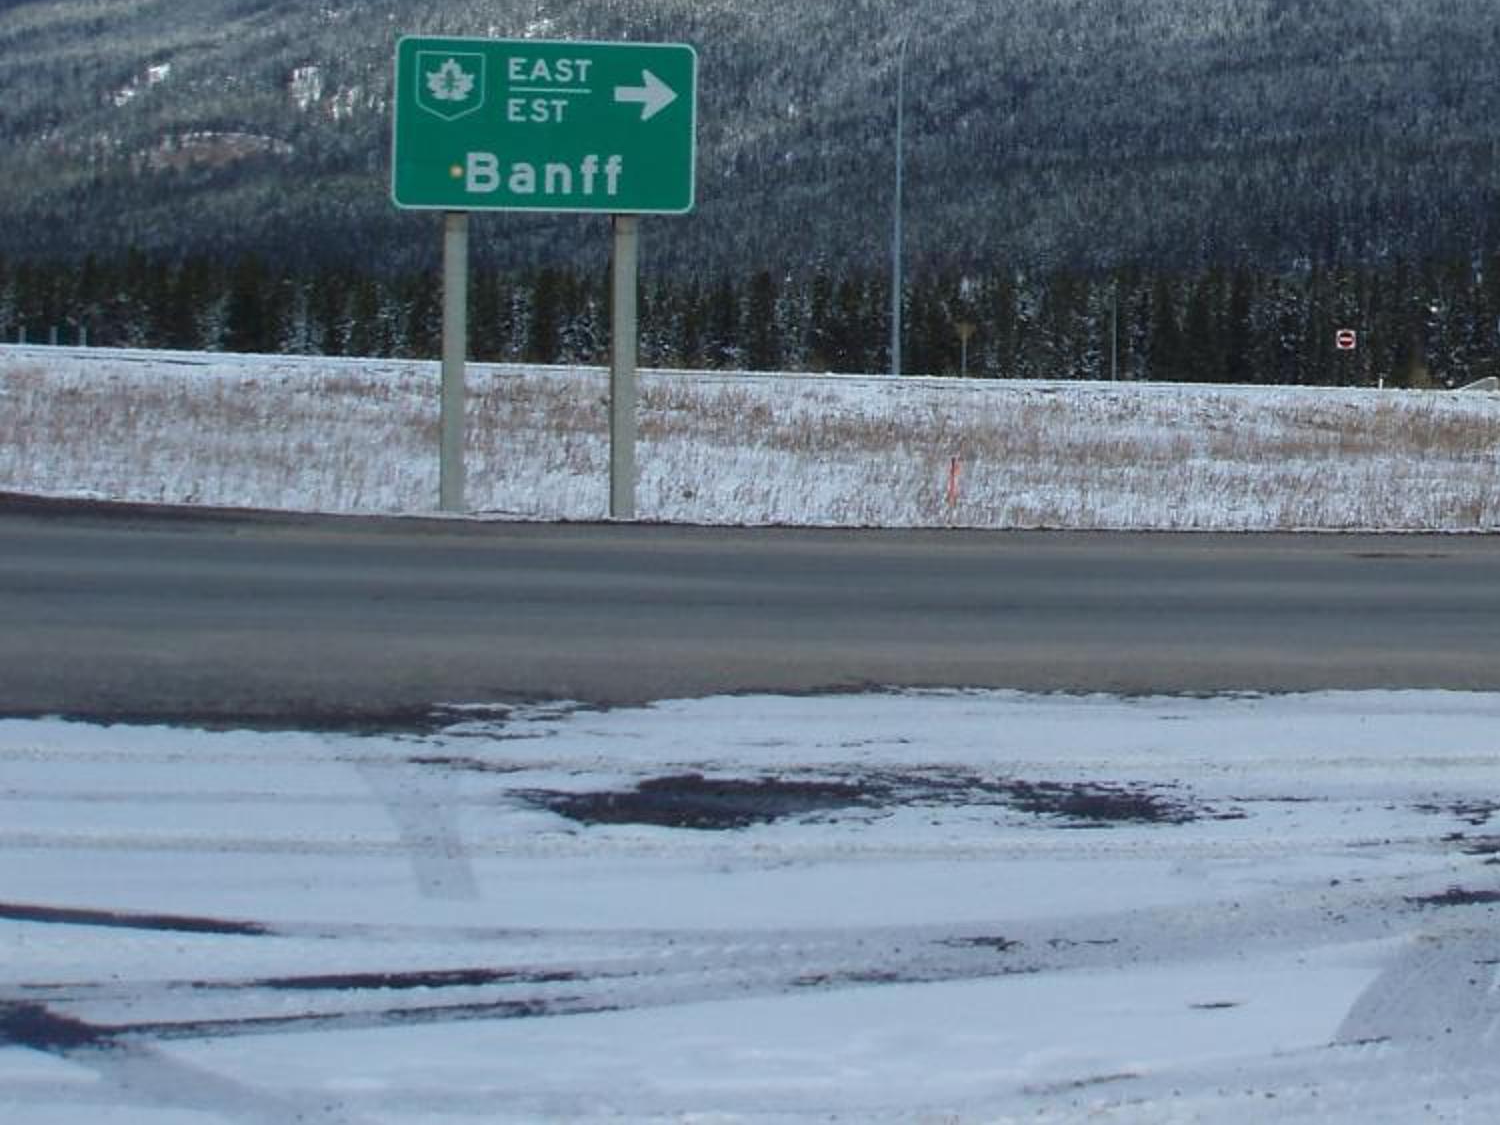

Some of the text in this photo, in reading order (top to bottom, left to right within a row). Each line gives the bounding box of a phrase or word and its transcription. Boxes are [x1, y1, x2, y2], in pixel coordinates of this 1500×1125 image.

[507, 56, 593, 83] EAST
[507, 98, 569, 123] EST
[465, 151, 623, 196] Banff
